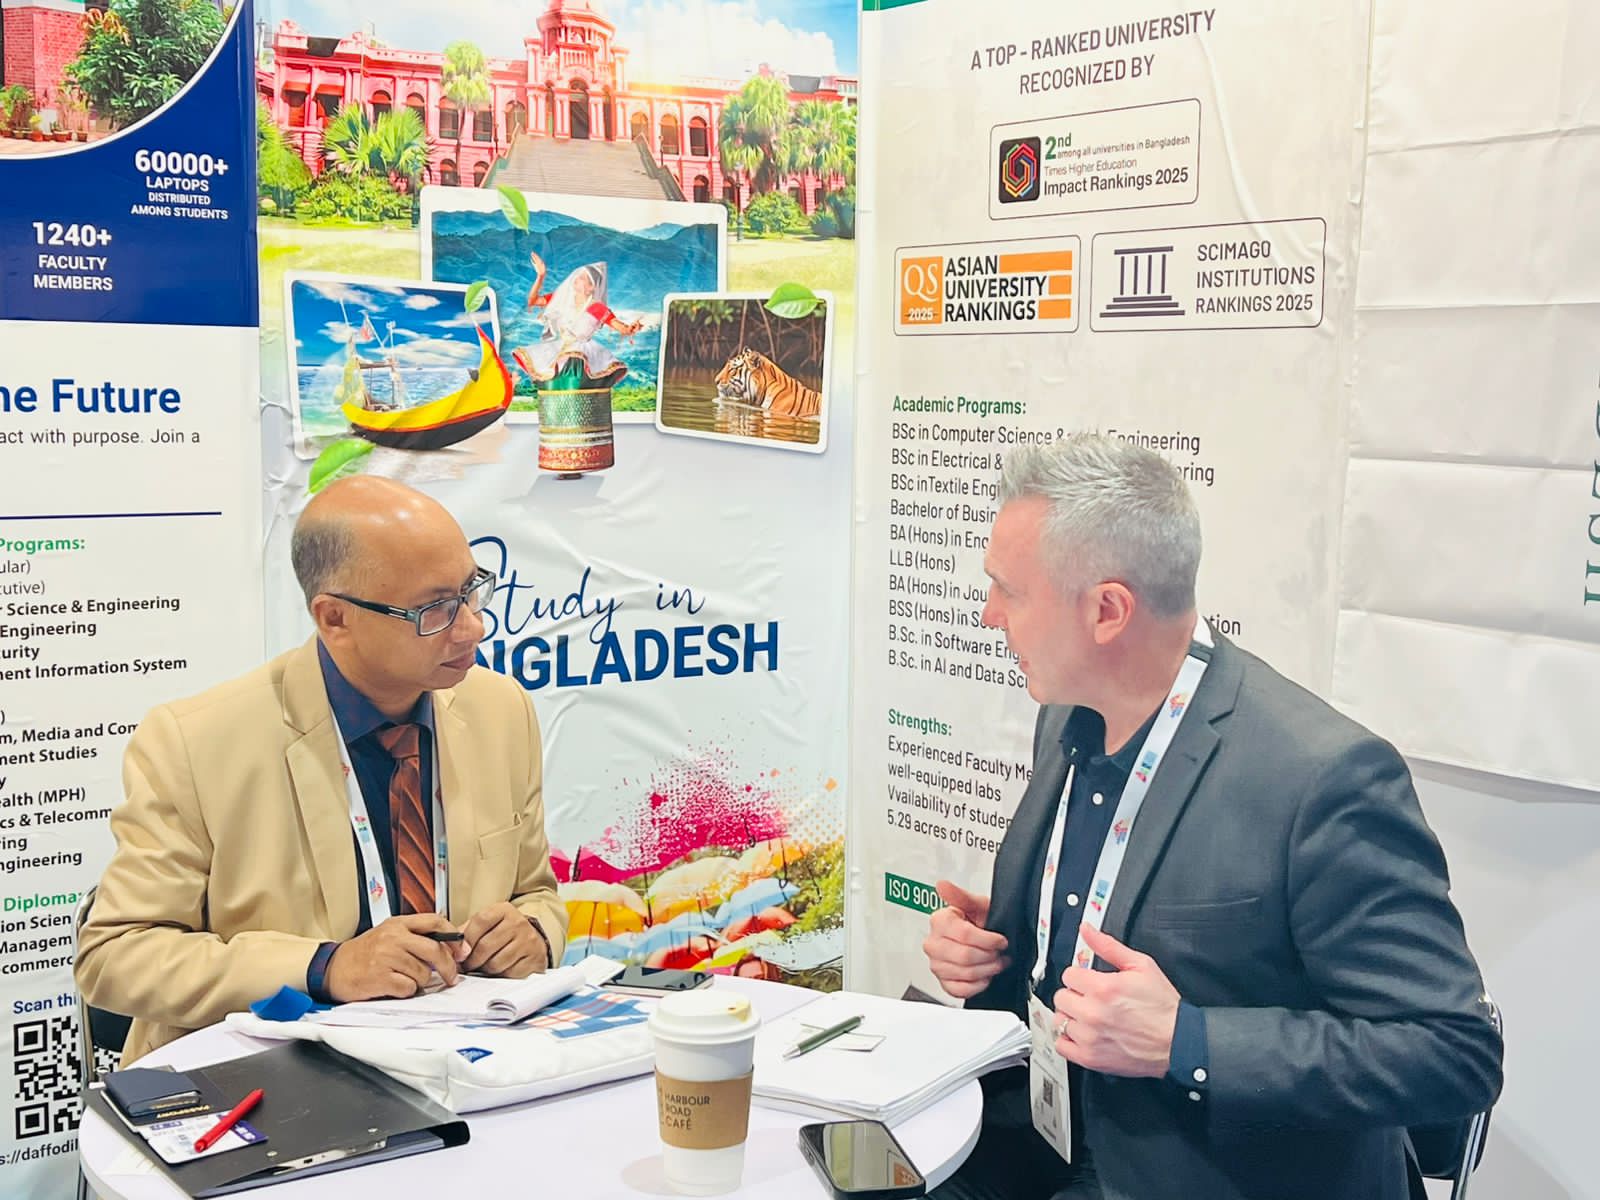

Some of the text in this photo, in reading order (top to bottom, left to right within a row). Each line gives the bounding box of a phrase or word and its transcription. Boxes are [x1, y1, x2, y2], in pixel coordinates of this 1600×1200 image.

[971, 50, 982, 71] A
[986, 44, 1017, 68] TOP
[1031, 29, 1100, 61] RANKED
[1105, 8, 1216, 47] UNIVERSITY
[1020, 54, 1155, 95] RECOGNIZED BY
[1045, 133, 1072, 160] 2nd
[1057, 135, 1190, 159] among all universities in Bangladesh
[135, 150, 229, 176] 60000+
[1044, 158, 1137, 176] Times Higher Education
[146, 176, 209, 192] LAPTOPS
[1044, 167, 1189, 197] Impact Rankings 2025
[148, 192, 211, 205] DISTRIBUTED
[131, 205, 228, 220] AMONG STUDENTS
[33, 222, 112, 247] 1240+
[1197, 240, 1271, 262] SCIMAGO
[38, 254, 107, 271] FACULTY
[945, 255, 998, 277] ASIAN
[34, 274, 113, 291] MEMBERS
[904, 263, 939, 302] QS
[945, 276, 1047, 299] UNIVERSITY
[1197, 266, 1315, 288] INSTITUTIONS
[908, 308, 934, 321] 2025
[945, 300, 1036, 322] RANKINGS
[1196, 294, 1313, 314] RANKINGS 2025
[52, 378, 181, 414] Future
[893, 395, 1026, 418] Academic Programs:
[30, 428, 66, 443] with
[72, 431, 144, 447] purpose.
[150, 428, 185, 444] Join
[192, 432, 201, 443] a
[892, 423, 915, 440] BSc
[918, 424, 929, 440] in
[932, 424, 994, 446] Computer
[998, 426, 1052, 445] Science
[892, 448, 915, 465] BSc
[918, 449, 928, 466] in
[931, 450, 991, 470] Electrical
[994, 453, 1003, 471] &
[891, 474, 914, 491] BSc
[891, 499, 943, 519] Bachelor
[946, 504, 959, 520] of
[890, 524, 906, 541] BA
[908, 525, 949, 547] (Hons)
[951, 530, 962, 547] in
[889, 549, 956, 574] LLB (Hons)
[0, 580, 46, 596] utive)
[656, 583, 706, 615] in
[889, 575, 988, 602] BA (Hons) in Jou
[7, 601, 67, 616] Science
[71, 600, 83, 613] &
[87, 596, 180, 615] Engineering
[889, 600, 913, 618] BSS
[914, 601, 954, 625] (Hons)
[957, 609, 968, 626] in
[0, 621, 97, 640] Engineering
[889, 624, 918, 645] B.Sc.
[921, 629, 932, 646] in
[935, 632, 992, 656] Software
[0, 645, 40, 661] urity
[35, 661, 129, 679] Information
[133, 658, 187, 675] System
[888, 650, 918, 669] B.Sc.
[920, 655, 931, 672] in
[934, 657, 946, 674] AI
[950, 663, 972, 680] and
[976, 664, 1004, 685] Data
[22, 727, 70, 743] Media
[74, 723, 103, 738] and
[888, 708, 952, 736] Strengths:
[39, 746, 98, 762] Studies
[888, 735, 962, 766] Experienced
[965, 752, 1012, 782] Faculty
[888, 763, 1001, 801] well-equipped labs
[38, 787, 86, 806] (MPH)
[888, 785, 950, 819] Vvailability
[953, 803, 966, 819] of
[19, 814, 31, 827] &
[888, 809, 912, 830] 5.29
[914, 819, 947, 841] acres
[950, 828, 963, 843] of
[889, 879, 910, 901] ISO
[30, 914, 72, 929] Scien
[13, 998, 52, 1014] Scan
